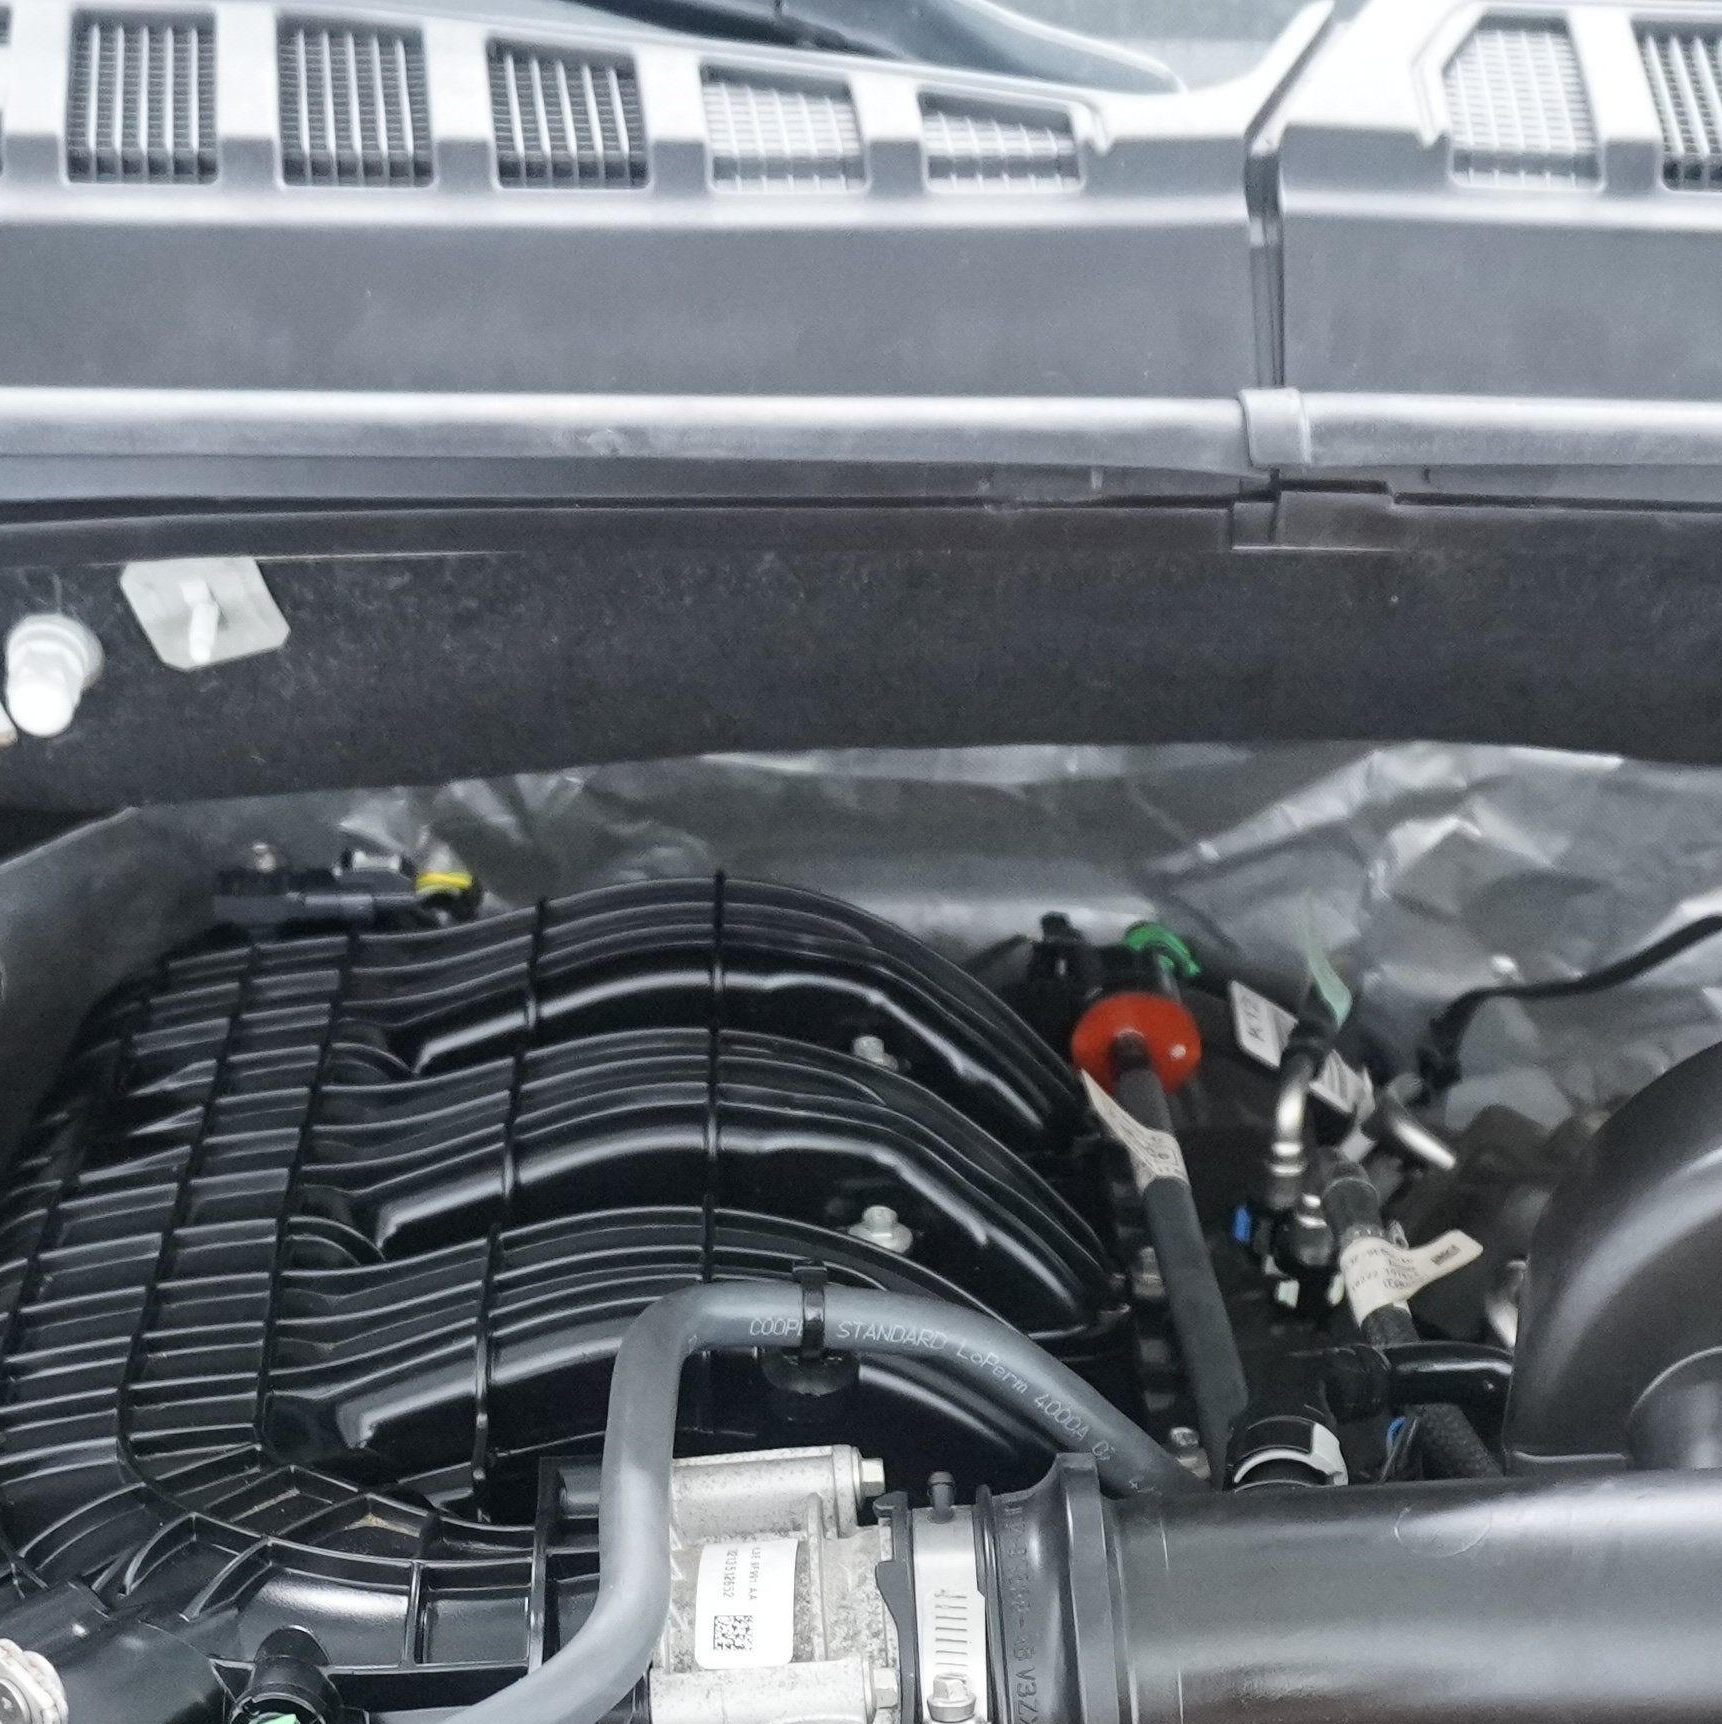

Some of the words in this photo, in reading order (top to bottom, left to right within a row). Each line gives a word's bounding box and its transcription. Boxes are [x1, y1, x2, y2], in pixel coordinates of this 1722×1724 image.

[836, 1320, 949, 1350] STANDARD
[956, 1340, 1028, 1394] LoPerm
[1034, 1393, 1090, 1440] 4000A
